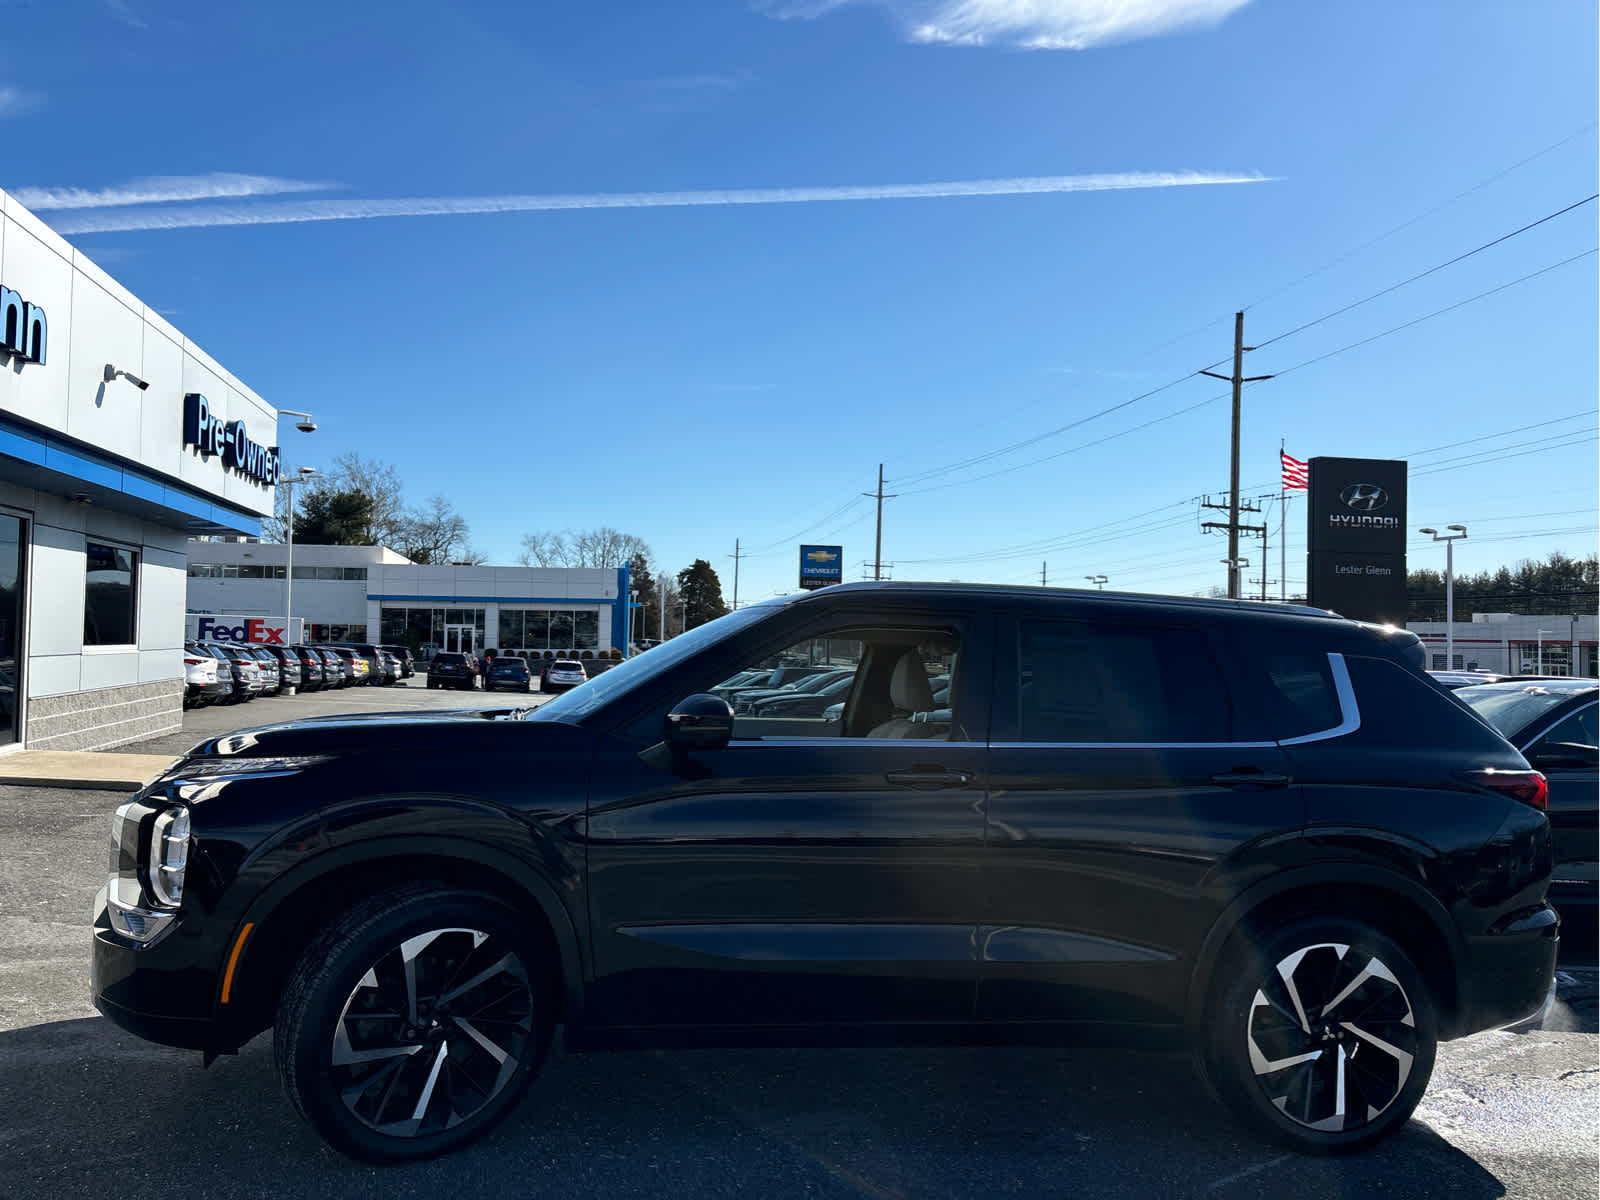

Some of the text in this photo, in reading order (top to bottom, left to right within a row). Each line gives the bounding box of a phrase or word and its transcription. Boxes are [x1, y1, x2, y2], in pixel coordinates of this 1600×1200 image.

[188, 393, 280, 486] Pre-Owned
[1329, 514, 1398, 528] HYUNDAI
[1335, 565, 1392, 576] Lester Glenn
[198, 617, 285, 644] FedEx
